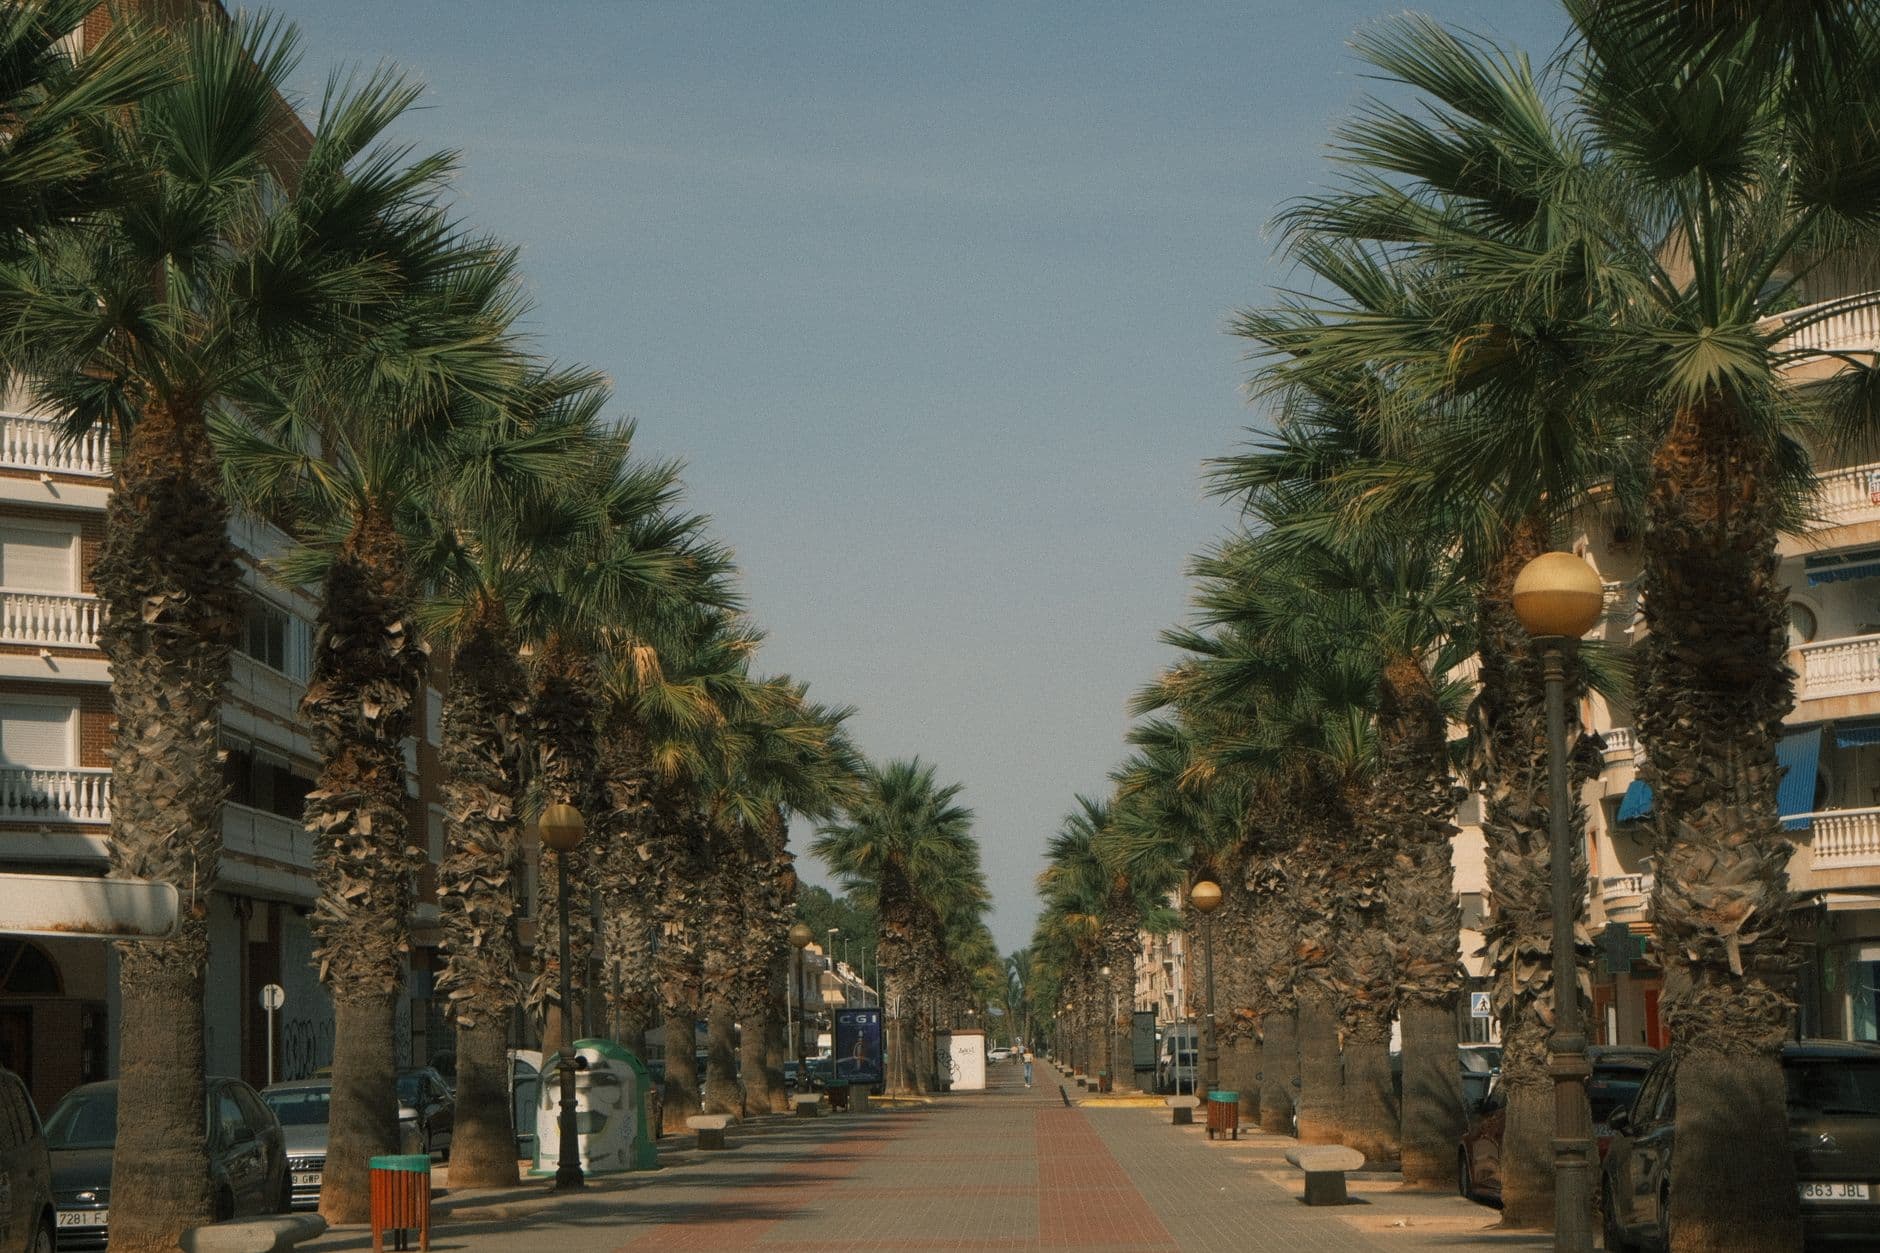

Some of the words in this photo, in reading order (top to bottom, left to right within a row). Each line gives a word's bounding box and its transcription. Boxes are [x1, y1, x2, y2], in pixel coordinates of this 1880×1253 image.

[1838, 1183, 1865, 1198] JBL
[60, 1212, 87, 1225] 7281
[94, 1212, 109, 1225] FJ
